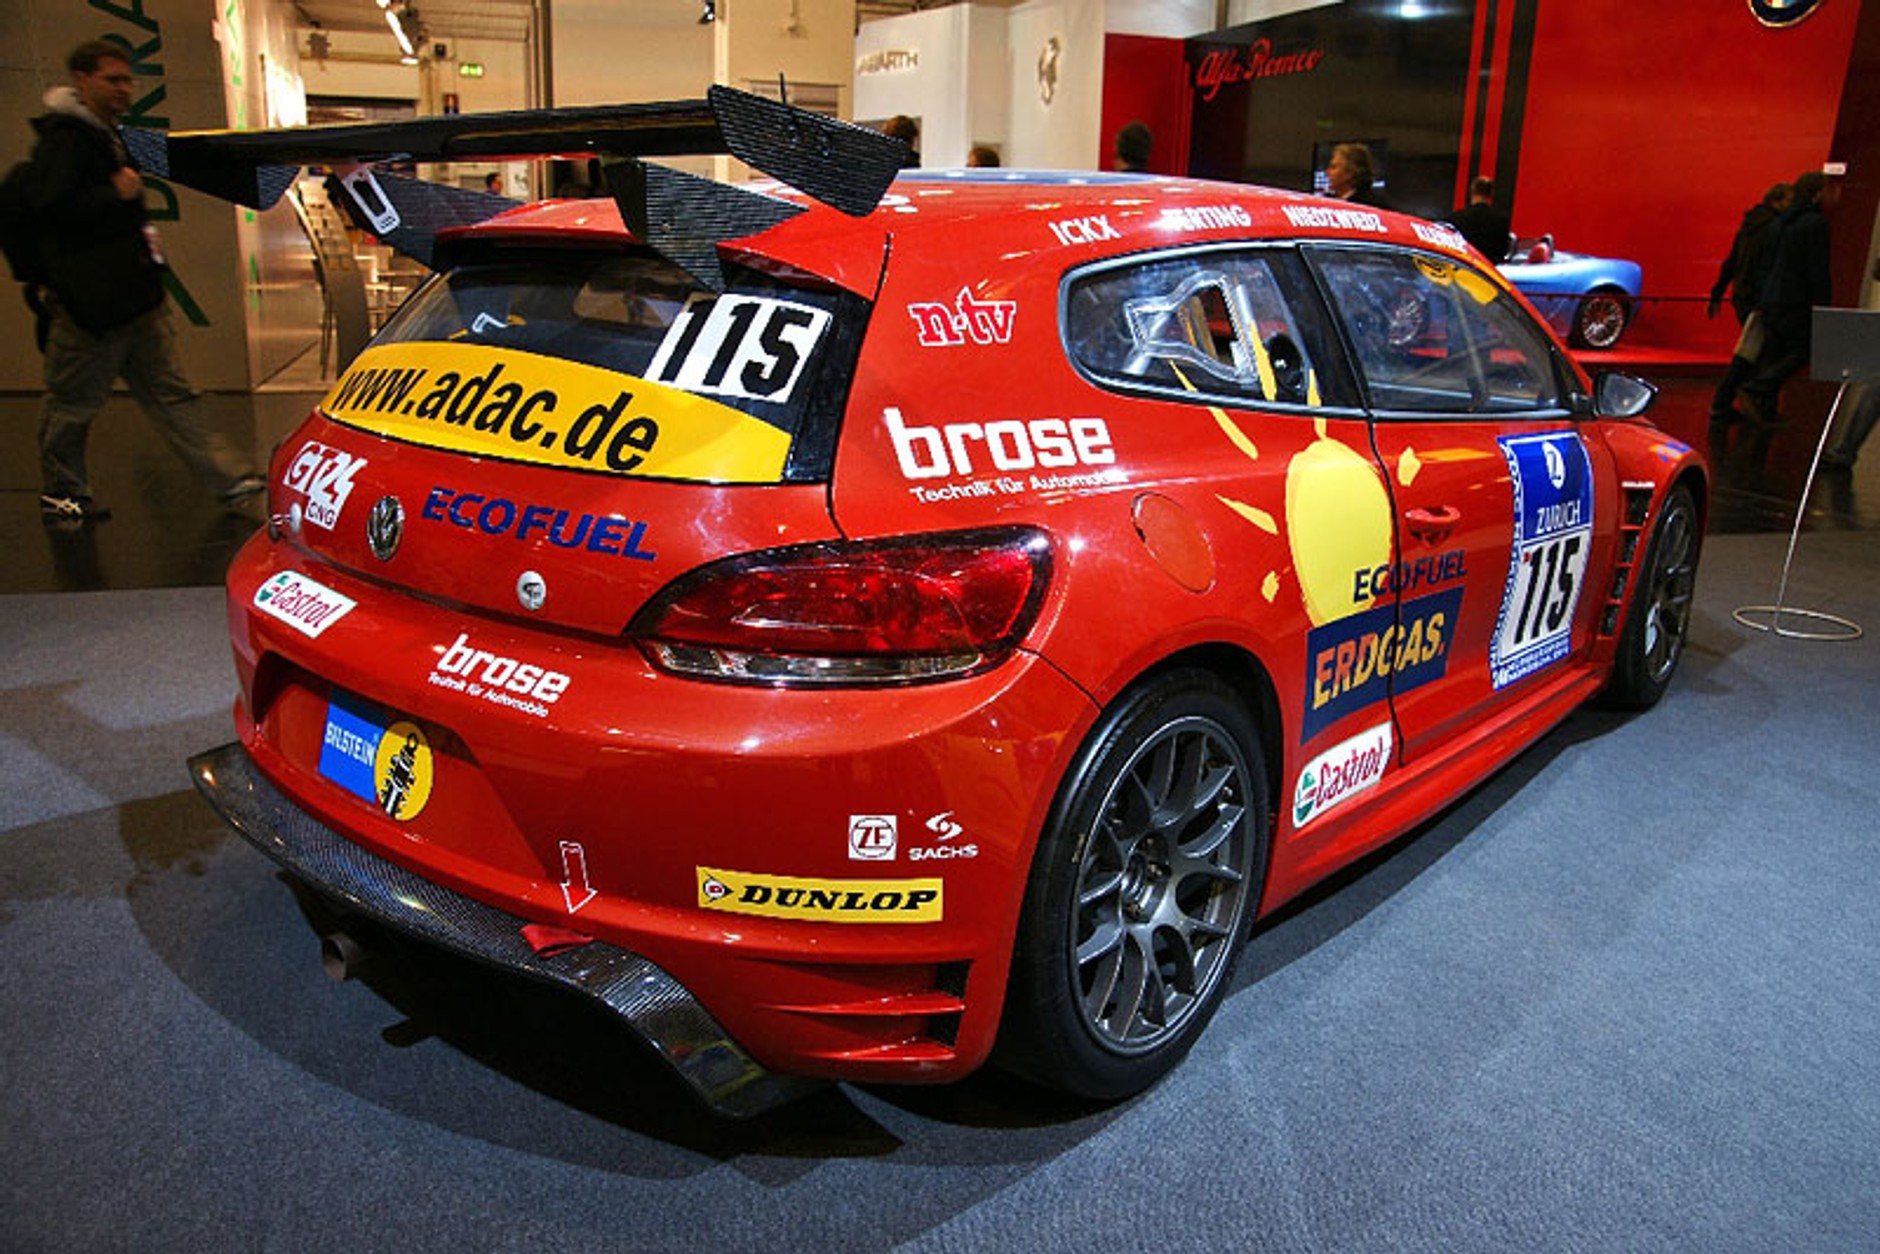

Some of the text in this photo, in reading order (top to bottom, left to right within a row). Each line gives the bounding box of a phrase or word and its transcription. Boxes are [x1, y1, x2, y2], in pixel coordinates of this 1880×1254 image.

[1196, 49, 1244, 101] Alfa
[1048, 213, 1122, 246] ICKX
[659, 301, 814, 398] 115
[331, 363, 660, 472] www.adac.de
[883, 407, 1116, 479] brose
[307, 502, 336, 527] CNG
[908, 481, 996, 504] Technik
[998, 476, 1025, 492] für
[421, 486, 656, 561] ECOFUEL
[1353, 550, 1468, 602] ECOFUEL
[1514, 536, 1580, 645] 115
[270, 582, 343, 628] Castrol
[436, 633, 571, 703] brose
[324, 721, 377, 767] BILSTEIN
[1315, 736, 1384, 810] Castrol
[908, 843, 979, 860] SACHS
[738, 885, 938, 911] DUNLOP
